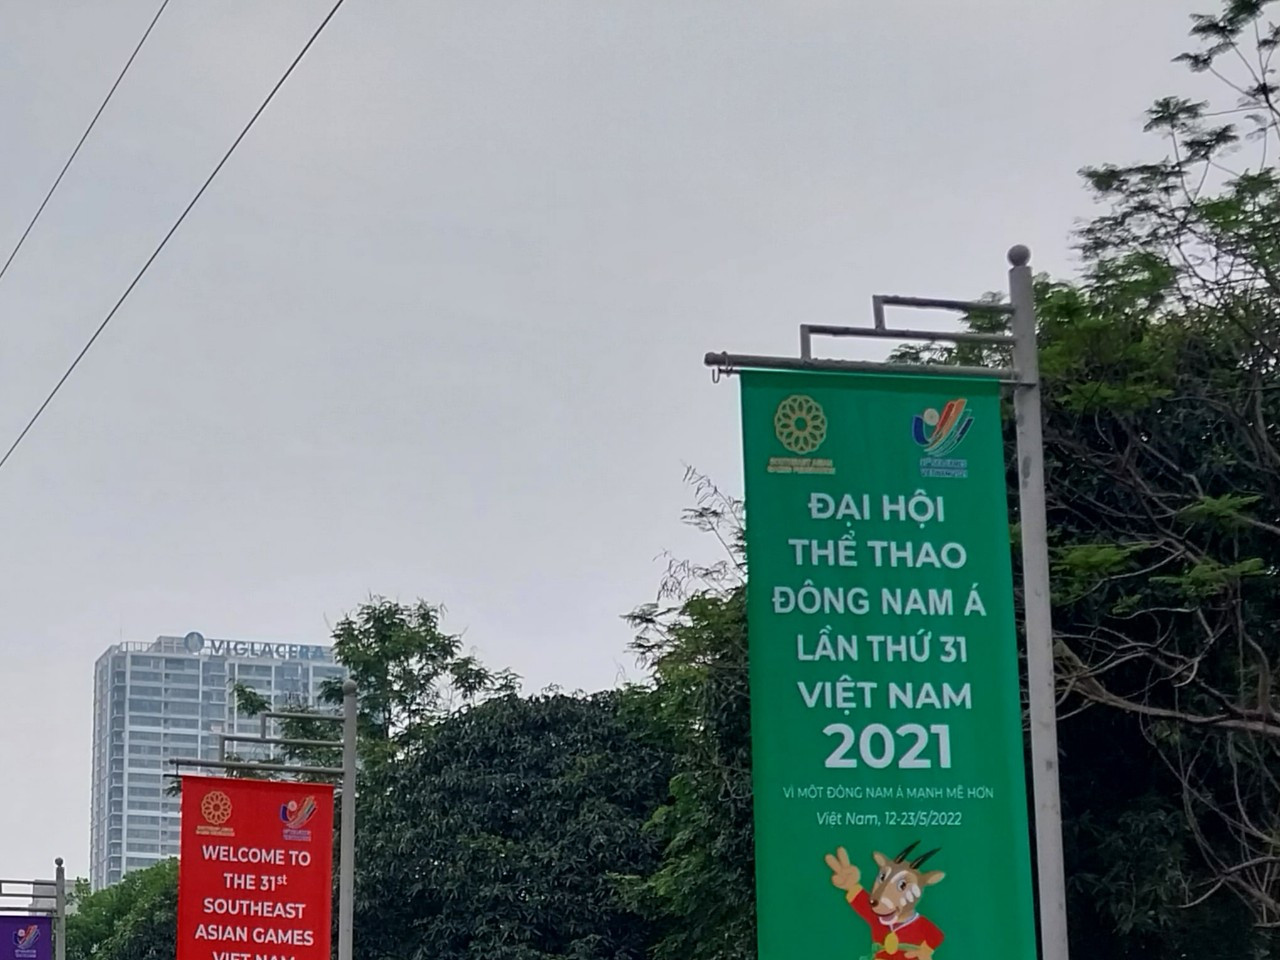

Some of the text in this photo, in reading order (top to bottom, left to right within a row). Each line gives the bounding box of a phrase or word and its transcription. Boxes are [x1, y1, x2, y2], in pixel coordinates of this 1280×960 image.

[808, 489, 945, 529] ĐẠI HỘI
[788, 530, 967, 568] THỂ THAO
[772, 579, 987, 617] ĐÔNG NAM Á
[797, 625, 968, 663] LẦN THỨ 31
[797, 675, 972, 716] VIỆT NAM
[822, 723, 952, 769] 2021
[783, 785, 795, 798] VÌ
[798, 785, 824, 801] MỘT
[826, 785, 863, 799] ĐÔNG
[866, 787, 893, 799] NAM
[896, 784, 904, 799] Á
[906, 787, 943, 802] MẠNH
[967, 786, 994, 799] HƠN
[817, 810, 963, 828] Việt Nam, 12-23/5/2022
[202, 845, 311, 866] WELCOME TO
[224, 872, 287, 891] THE 31st
[203, 898, 306, 919] SOUTHEAST
[194, 924, 314, 946] ASIAN GAMES
